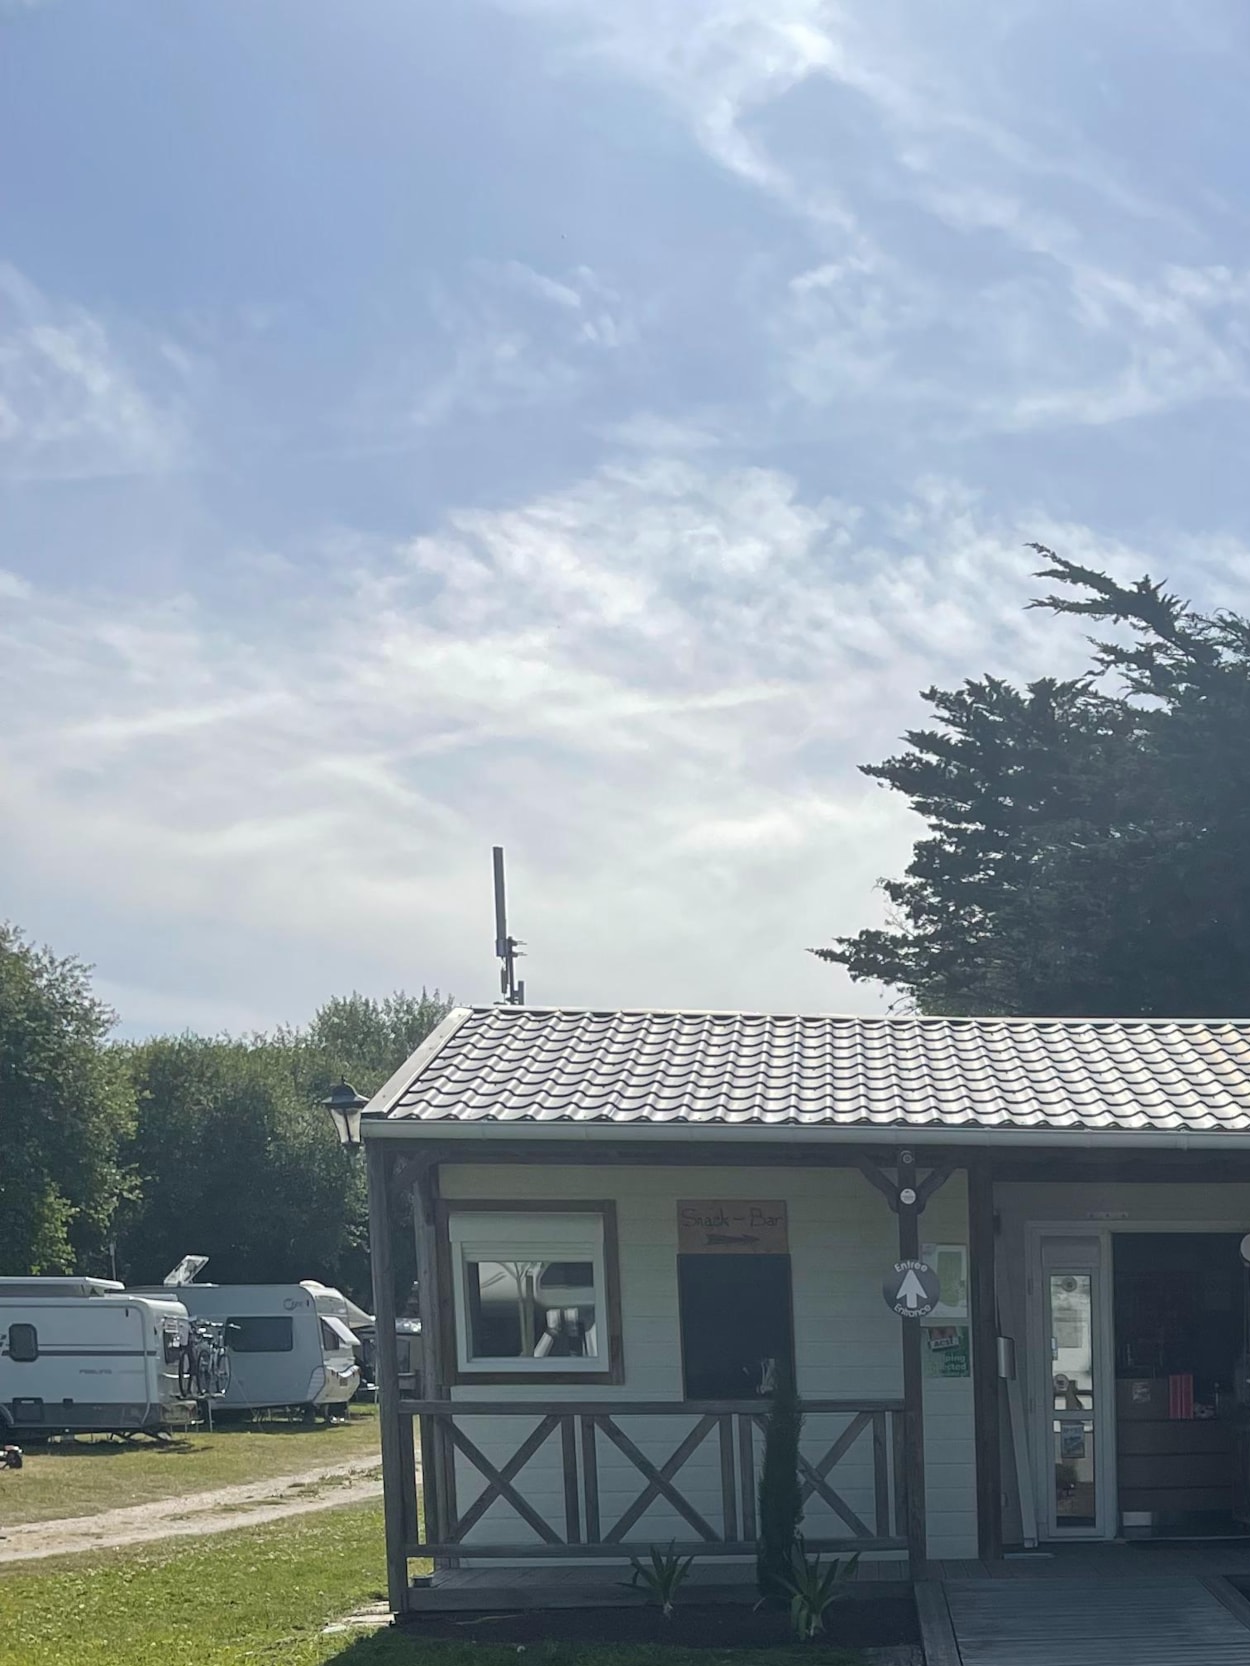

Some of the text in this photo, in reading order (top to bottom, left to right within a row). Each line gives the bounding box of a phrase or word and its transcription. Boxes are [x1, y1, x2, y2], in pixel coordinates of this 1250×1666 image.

[681, 1207, 730, 1228] Snack
[750, 1207, 784, 1227] Bar
[894, 1303, 932, 1318] Entrance
